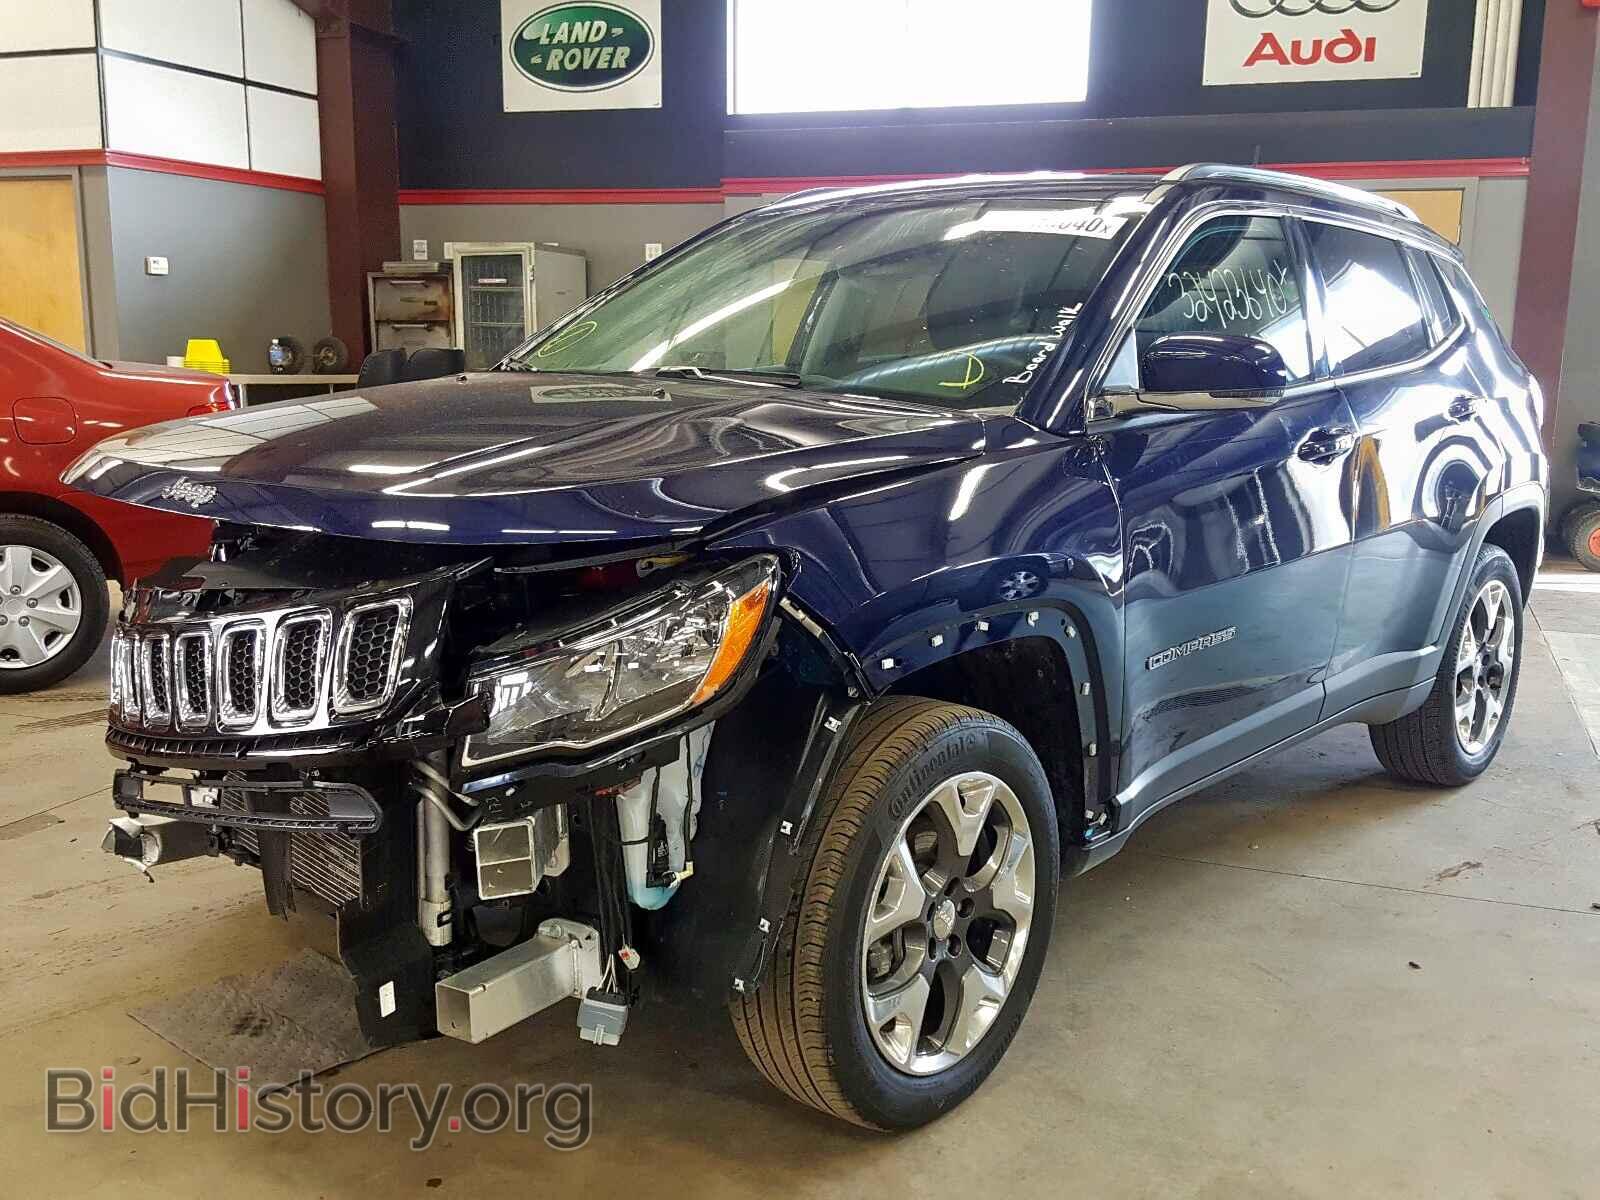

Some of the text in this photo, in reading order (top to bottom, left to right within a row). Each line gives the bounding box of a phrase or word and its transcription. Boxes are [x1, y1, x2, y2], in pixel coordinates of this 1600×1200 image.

[539, 20, 607, 45] LAND
[1242, 28, 1377, 67] Audi
[545, 46, 631, 71] ROVER
[1145, 625, 1238, 671] COMPASS
